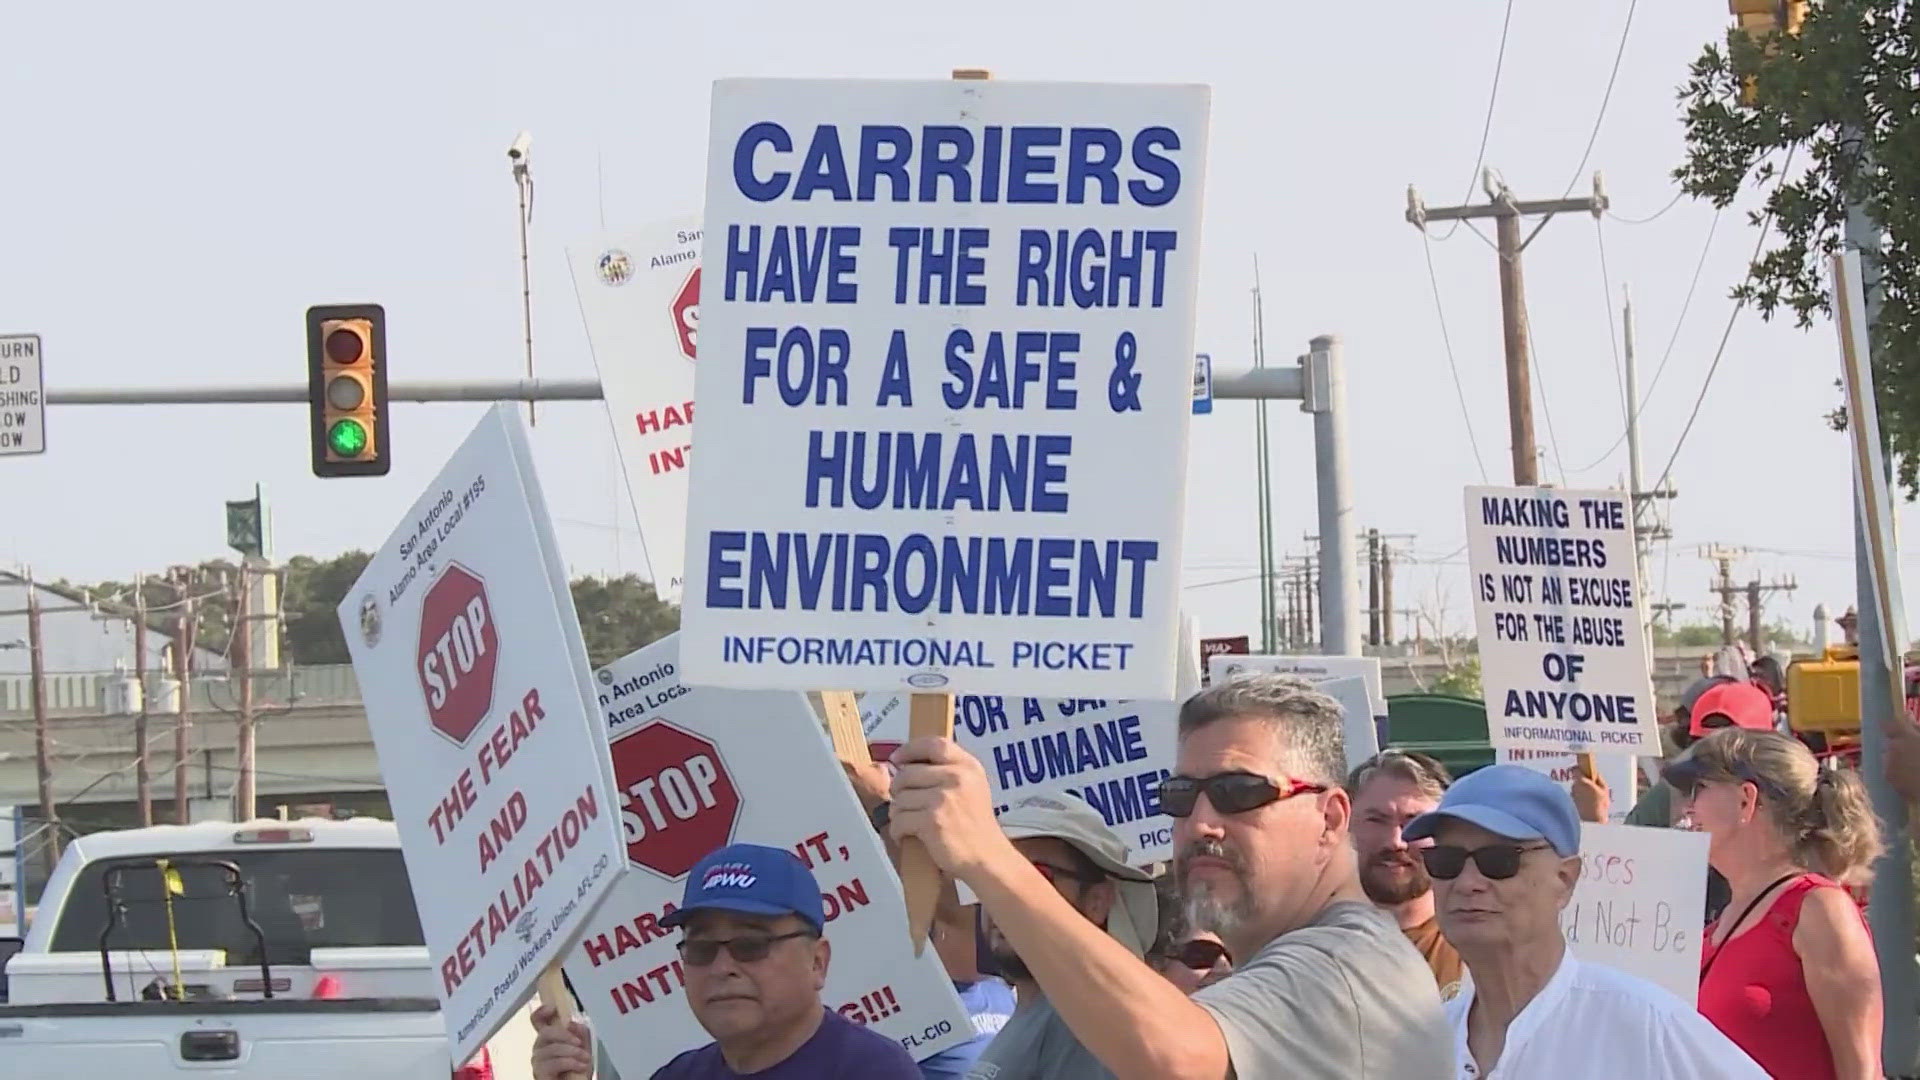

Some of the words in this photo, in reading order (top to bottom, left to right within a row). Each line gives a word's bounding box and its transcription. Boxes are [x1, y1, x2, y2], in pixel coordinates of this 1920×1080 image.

[733, 122, 1181, 206] CARRIERS
[650, 249, 696, 269] Alamo
[724, 225, 861, 303] HAVE
[889, 227, 990, 305] THE
[1016, 228, 1178, 308] RIGHT
[743, 326, 850, 407] FOR
[877, 329, 912, 405] A
[942, 329, 1080, 411] SAFE
[1108, 331, 1142, 412] &
[648, 445, 692, 474] IN
[805, 430, 1072, 513] HUMANE
[400, 534, 418, 561] San
[418, 489, 454, 537] Antonio
[1482, 496, 1569, 529] MAKING
[1580, 500, 1625, 530] THE
[389, 566, 416, 606] Alamo
[416, 538, 439, 569] Area
[437, 502, 464, 543] Local
[463, 474, 486, 511] #195
[1496, 536, 1607, 568] NUMBERS
[706, 531, 1159, 619] ENVIRONMENT
[1479, 573, 1496, 602] IS
[1503, 576, 1533, 604] NOT
[1542, 577, 1561, 605] AN
[1569, 577, 1633, 608] EXCUSE
[423, 596, 486, 710] STOP
[723, 636, 994, 668] INFORMATIONAL
[1012, 641, 1134, 671] PICKET
[1495, 613, 1528, 641] FOR
[1534, 615, 1565, 643] THE
[1573, 616, 1625, 647] ABUSE
[613, 661, 676, 701] Antonio
[1543, 653, 1584, 682] OF
[607, 702, 645, 728] Area
[649, 686, 693, 710] Loca
[1504, 689, 1638, 724] ANYONE
[993, 715, 1147, 790] HUMANE
[1504, 726, 1596, 743] INFORMATIONAL
[1601, 731, 1644, 745] PICKET
[428, 767, 477, 846] THE
[478, 687, 546, 786] FEAR
[620, 754, 718, 845] STOP
[477, 790, 529, 874] AND
[1139, 826, 1174, 849] PIC
[440, 784, 600, 998] RETALIATION
[1595, 901, 1641, 948] Not
[1653, 902, 1687, 952] Be
[458, 995, 495, 1044] American
[493, 963, 520, 1001] Postal
[518, 928, 553, 971] Workers
[901, 1019, 952, 1050] FL-CIO
